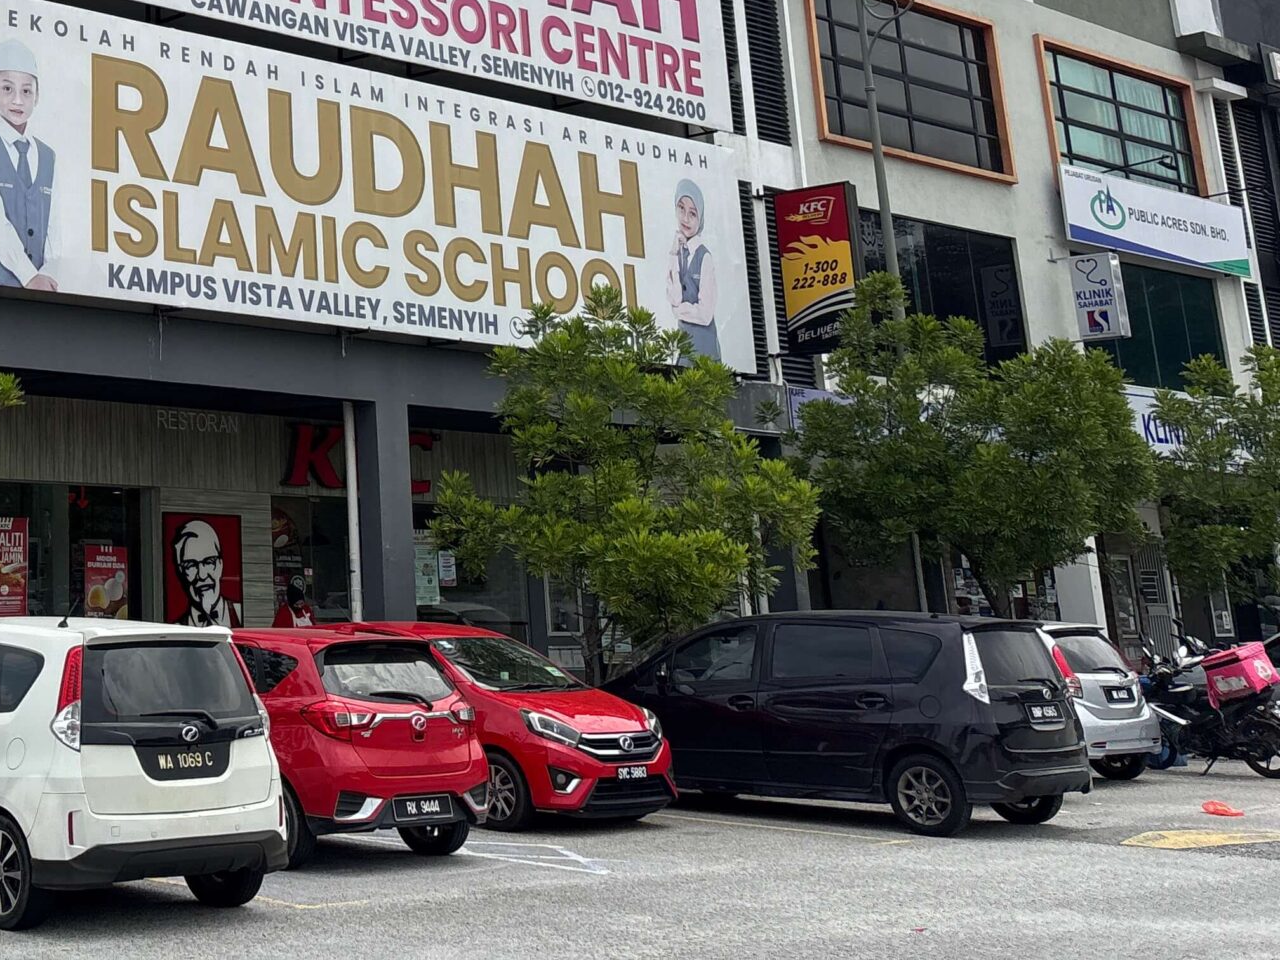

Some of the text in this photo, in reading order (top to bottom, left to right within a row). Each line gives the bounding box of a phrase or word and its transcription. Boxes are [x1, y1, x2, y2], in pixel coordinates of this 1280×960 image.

[541, 15, 705, 98] CENTRE
[332, 19, 396, 52] VISTA
[398, 34, 478, 74] VALLEY,
[481, 53, 574, 92] SEMENYIH
[598, 79, 664, 112] 012-924
[666, 96, 706, 121] 2600
[160, 42, 279, 81] RENDAH
[301, 70, 384, 103] ISLAM
[404, 92, 545, 136] INTEGRASI
[562, 126, 588, 145] AR
[605, 135, 708, 169] RAUDHAH
[91, 53, 645, 259] RAUDHAH
[799, 200, 827, 214] KFC
[91, 178, 390, 289] ISLAMIC
[1127, 207, 1230, 242] PUBLIC ACRES SDN. BHD.
[804, 259, 839, 275] 1-300
[791, 272, 847, 290] 222-888
[108, 262, 499, 336] KAMPUS VISTA VALLEY, SEMENYIH
[1075, 288, 1113, 301] KLINIK
[1078, 299, 1113, 309] SAHABAT
[156, 409, 239, 433] RESTORAN
[1142, 413, 1187, 446] KLINI
[158, 751, 213, 770] WA 1069 C
[617, 766, 647, 779] SYC 5883
[406, 799, 440, 815] RX 9444
